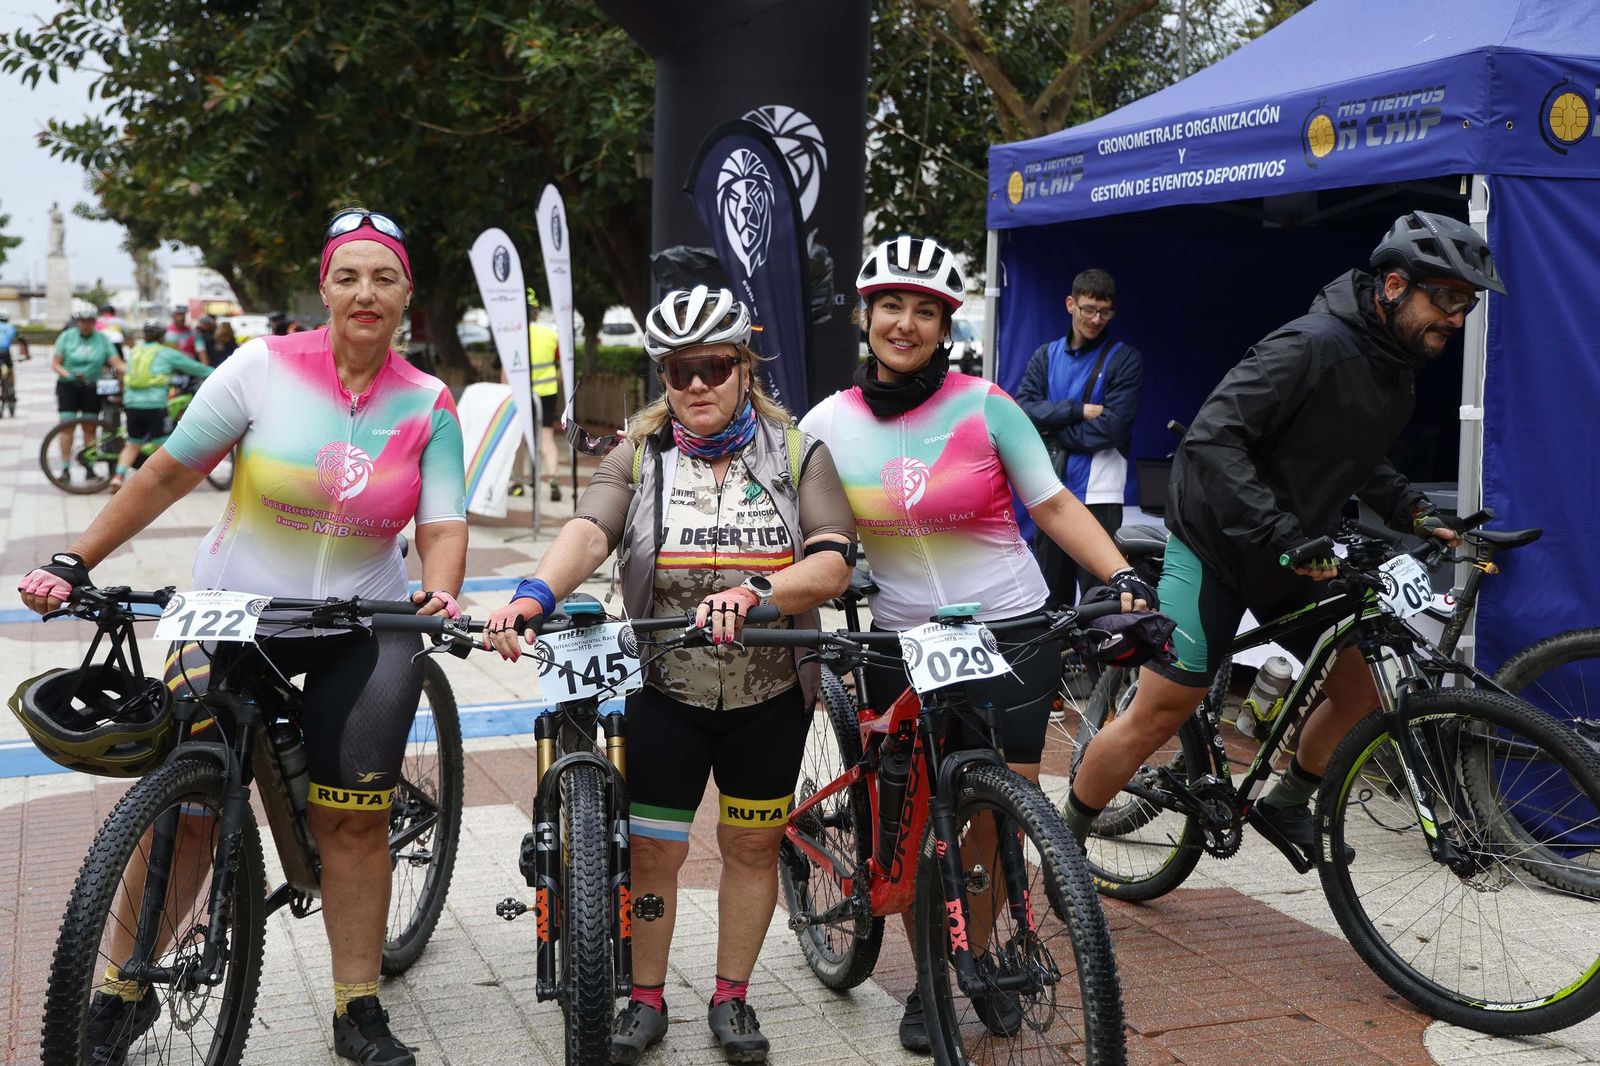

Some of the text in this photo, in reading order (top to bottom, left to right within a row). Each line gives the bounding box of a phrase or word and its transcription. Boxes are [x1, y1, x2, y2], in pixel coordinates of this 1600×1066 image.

[1337, 84, 1446, 117] MIS TIEMPOS
[1097, 104, 1281, 156] CRONOMETRAJE ORGANIZACIÓN
[1366, 106, 1442, 147] CHIP
[1178, 148, 1187, 164] Y
[1090, 159, 1286, 203] GESTIÓN DE EVENTOS DEPORTIVOS
[372, 428, 401, 436] GSPORT
[924, 431, 955, 445] GSPORT
[262, 495, 376, 528] INTERCONTINENTAL
[949, 511, 976, 522] RACE
[277, 515, 309, 530] Europa
[313, 520, 350, 537] MTB
[680, 525, 789, 546] DESERTICA
[900, 527, 932, 537] MTB
[177, 610, 246, 637] 122
[578, 643, 592, 652] MTB
[558, 652, 628, 694] 145
[927, 646, 994, 682] 029
[318, 788, 383, 805] RUTA
[727, 806, 783, 821] RUTA
[945, 898, 969, 953] FOX
